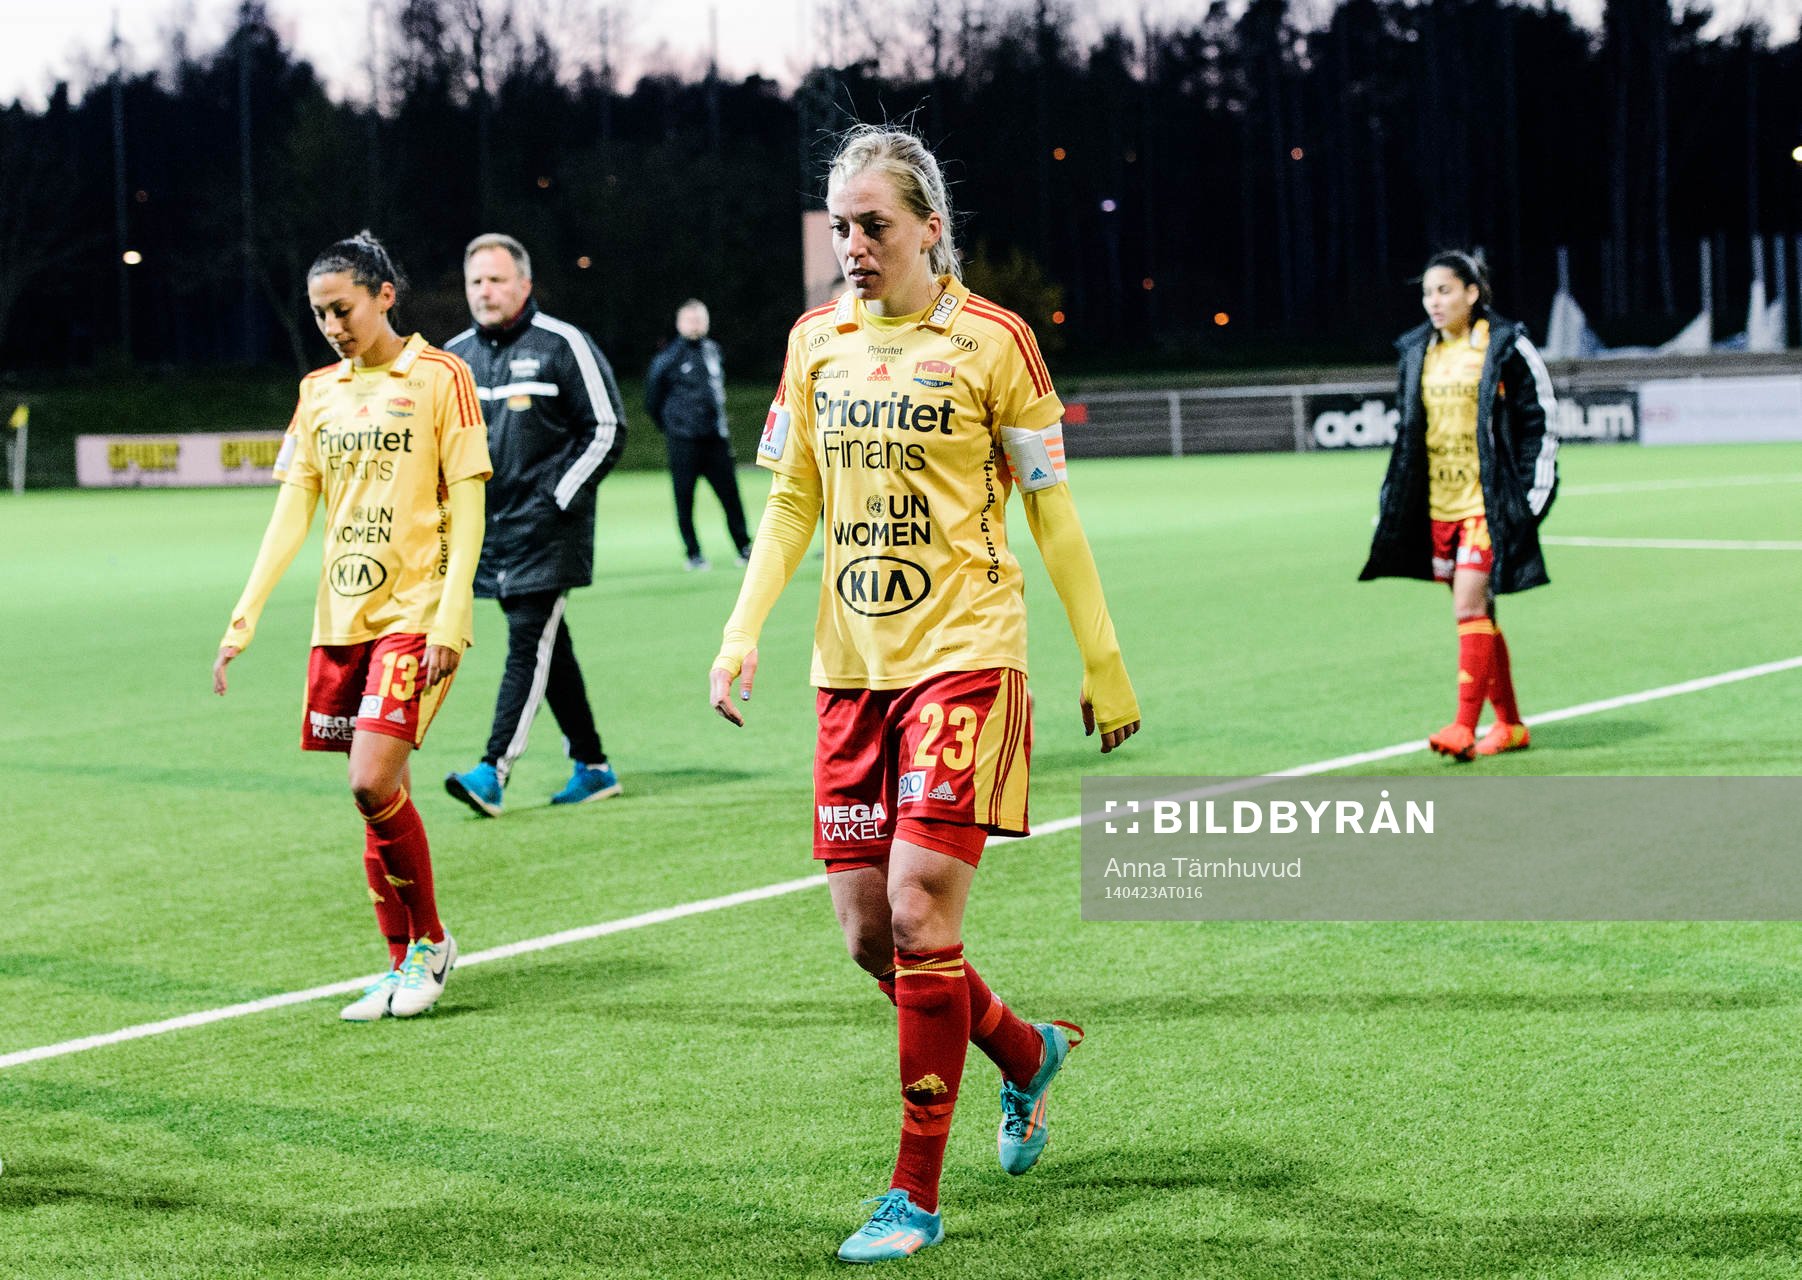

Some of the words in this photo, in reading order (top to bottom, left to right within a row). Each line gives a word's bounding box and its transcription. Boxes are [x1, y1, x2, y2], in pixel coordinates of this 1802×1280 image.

[867, 345, 903, 355] Prioritet
[815, 390, 956, 435] Prioritet
[320, 424, 414, 454] Prioritet
[823, 431, 926, 471] Finans
[367, 506, 393, 523] UN
[889, 494, 930, 520] UN
[834, 521, 931, 547] WOMEN
[438, 535, 449, 576] Oscar
[985, 536, 999, 585] Oscar
[337, 563, 373, 586] KIA
[849, 569, 914, 603] KIA
[377, 651, 420, 702] 13
[312, 725, 354, 741] KAKE
[913, 702, 978, 771] 23
[818, 802, 887, 824] MEGA
[820, 822, 888, 842] KAKEL
